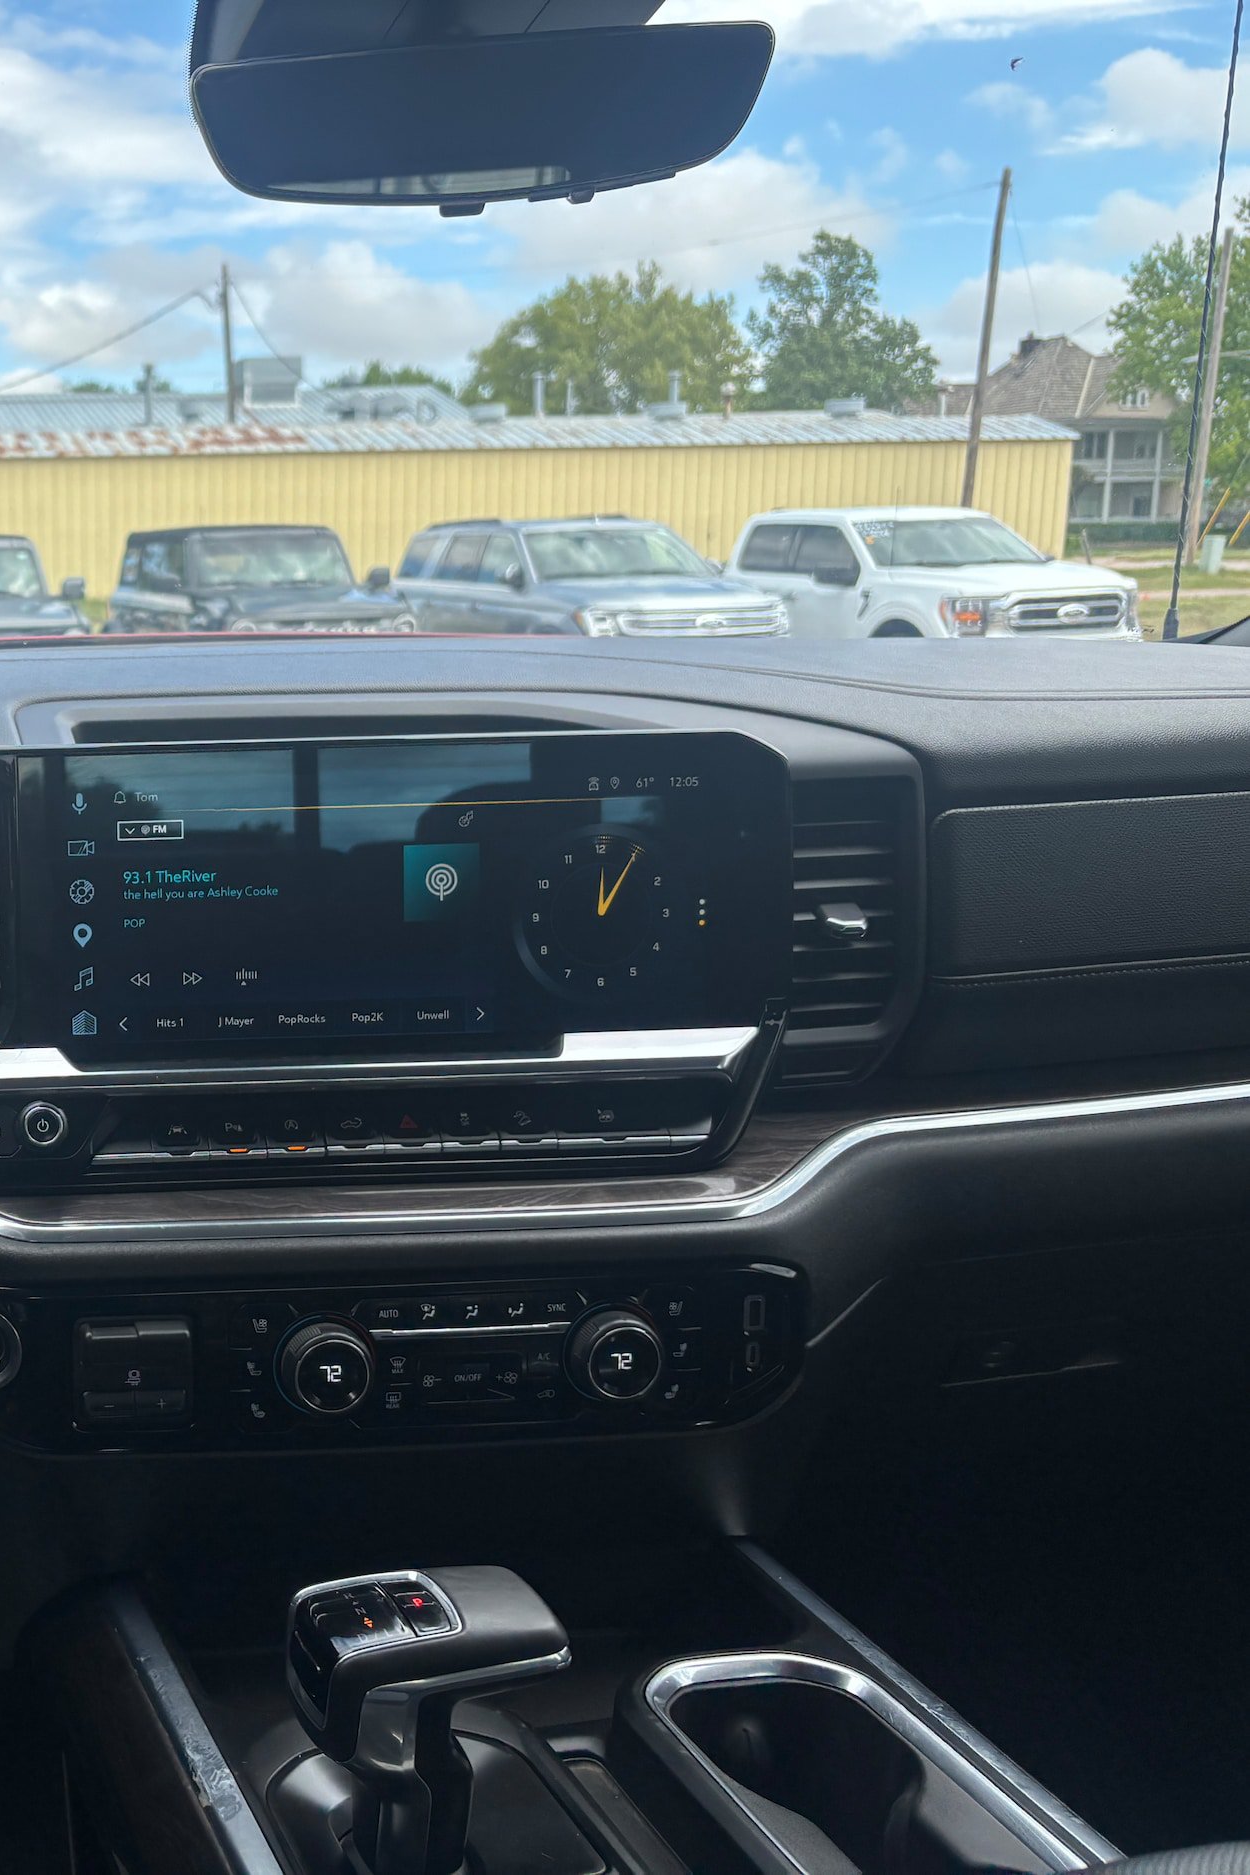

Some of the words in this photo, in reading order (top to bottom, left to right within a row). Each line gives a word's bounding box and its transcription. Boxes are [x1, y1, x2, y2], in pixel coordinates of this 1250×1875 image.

[636, 776, 654, 788] 61°
[670, 776, 699, 788] 12:05
[135, 792, 158, 802] Tom
[152, 824, 167, 834] FM
[595, 844, 606, 854] 12
[564, 854, 572, 864] 11
[123, 870, 152, 885] 93.1
[155, 870, 216, 884] TheRiver
[654, 876, 661, 886] 2
[538, 880, 549, 889] 10
[123, 889, 141, 900] the
[144, 888, 162, 900] hell
[165, 890, 182, 902] you
[183, 890, 204, 899] are
[207, 887, 243, 900] Ashley
[245, 885, 279, 897] Cooke
[532, 913, 539, 922] 9
[662, 908, 670, 918] 3
[123, 918, 146, 929] POP
[540, 945, 548, 955] 8
[653, 942, 660, 952] 4
[565, 969, 572, 978] 7
[630, 967, 637, 976] 5
[597, 977, 604, 986] 6
[278, 1014, 326, 1026] PopRocks
[352, 1012, 384, 1024] Pop2K
[417, 1010, 450, 1021] Unwell
[156, 1017, 176, 1028] Hits
[179, 1017, 184, 1028] 1
[218, 1016, 223, 1028] J
[224, 1016, 255, 1029] Mayer
[547, 1303, 566, 1312] SYNC
[379, 1309, 399, 1318] AUTO
[610, 1352, 632, 1370] 72
[319, 1365, 342, 1383] 72
[454, 1374, 482, 1382] ON/OFF
[412, 1597, 424, 1608] P
